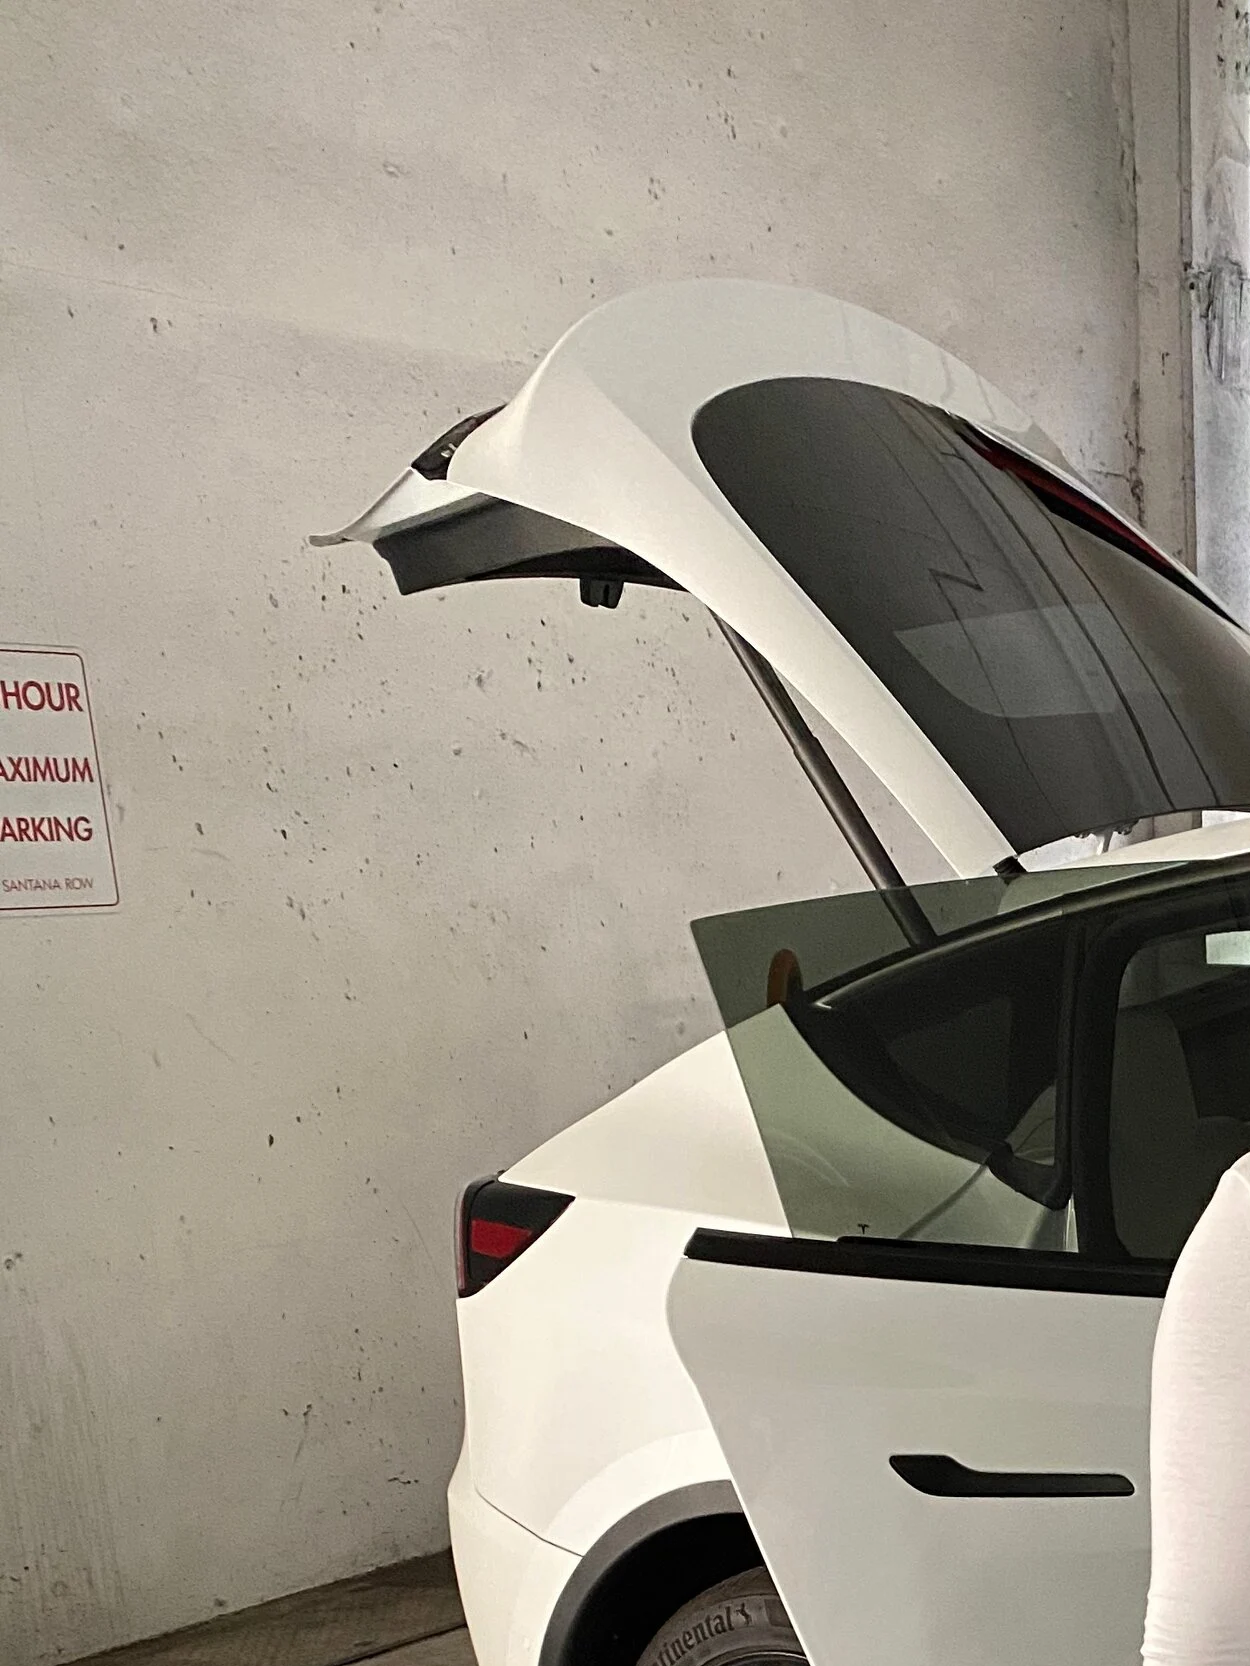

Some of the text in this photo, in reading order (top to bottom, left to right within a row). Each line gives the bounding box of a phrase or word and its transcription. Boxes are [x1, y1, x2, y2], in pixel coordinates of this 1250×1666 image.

[0, 680, 84, 712] HOUR
[2, 877, 94, 892] SANTANA ROW
